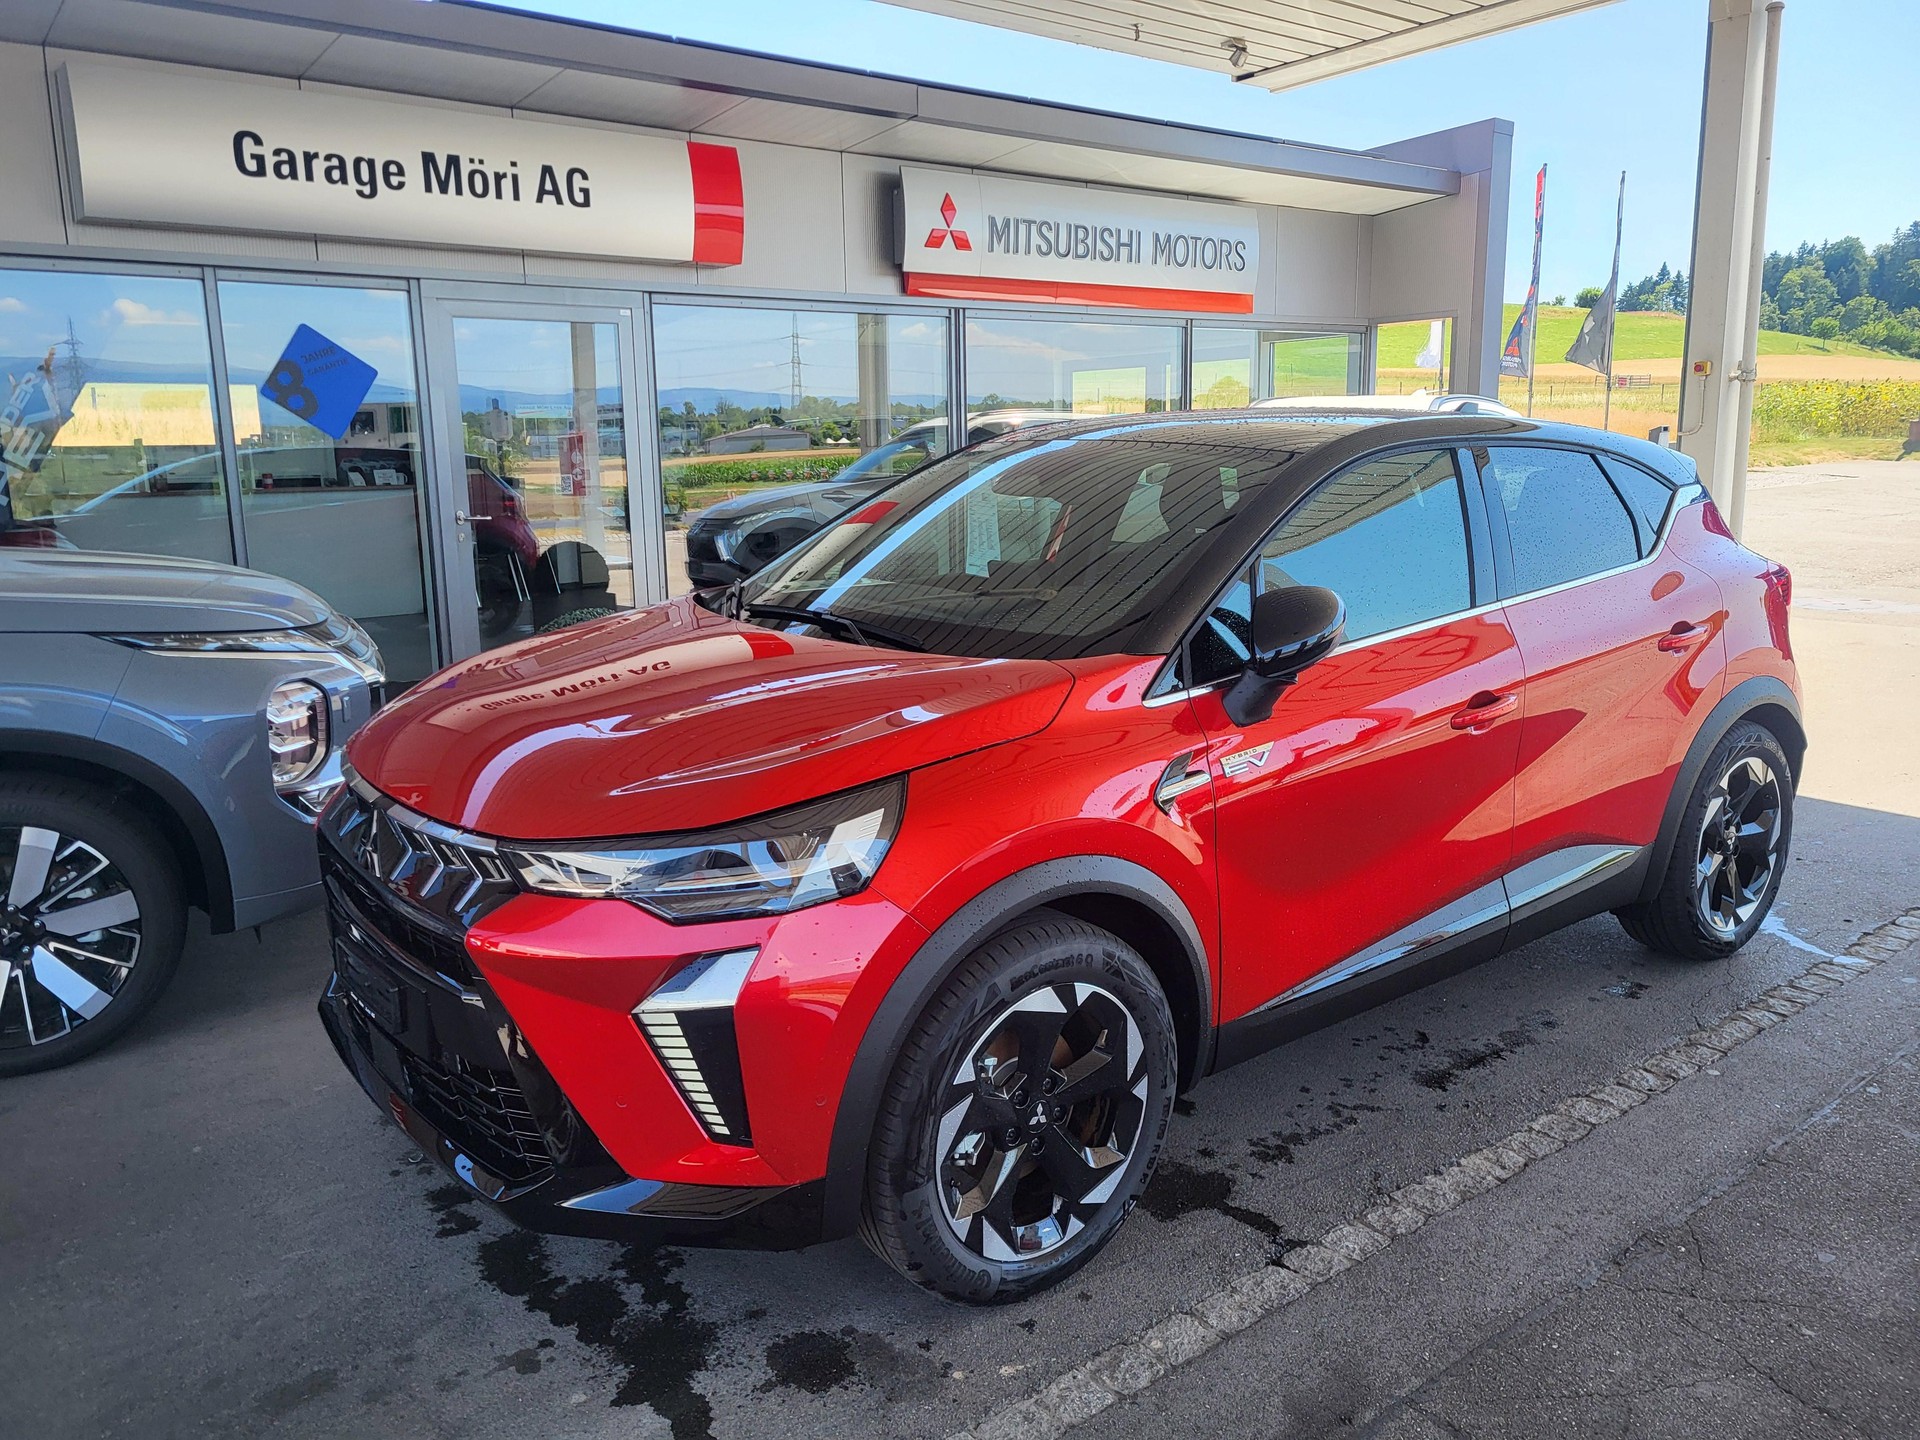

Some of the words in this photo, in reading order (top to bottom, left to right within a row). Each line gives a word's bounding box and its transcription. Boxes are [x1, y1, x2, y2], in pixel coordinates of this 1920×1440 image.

[233, 130, 406, 200] Garage
[420, 150, 521, 202] Möri
[535, 164, 592, 208] AG
[987, 214, 1141, 264] MITSUBISHI
[1151, 230, 1247, 273] MOTORS
[265, 358, 319, 421] 8
[1221, 745, 1273, 778] EV
[1225, 748, 1258, 762] HYBRID
